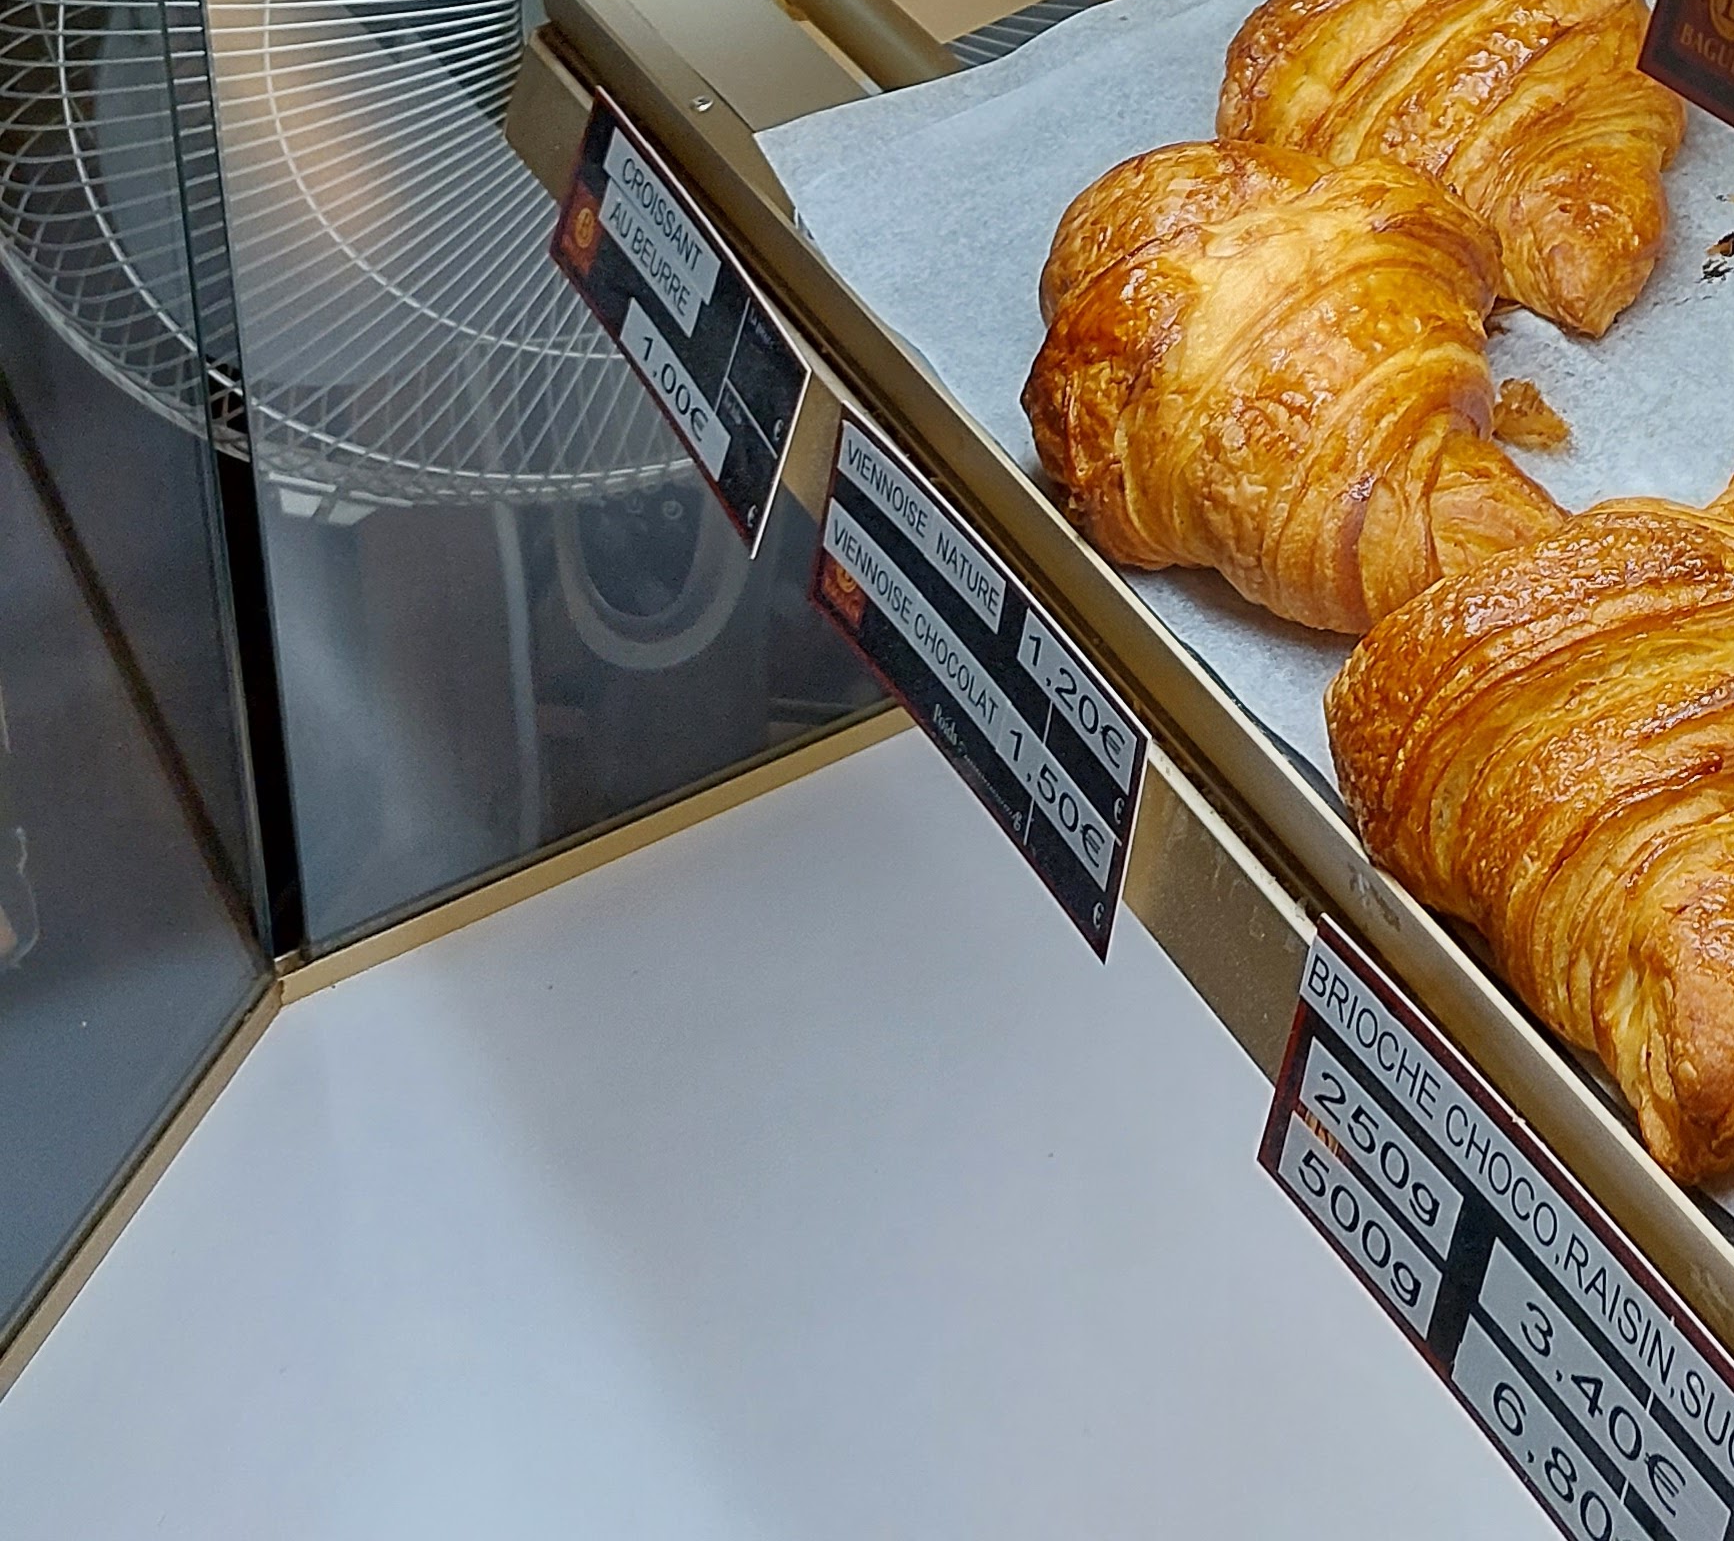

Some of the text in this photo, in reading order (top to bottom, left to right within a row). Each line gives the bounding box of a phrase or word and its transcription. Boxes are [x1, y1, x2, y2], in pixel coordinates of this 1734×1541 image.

[608, 201, 692, 317] AU BEURRE
[621, 156, 704, 273] CROISSANT
[847, 437, 1127, 771] VIENNOISE NATURE 1,20€
[832, 519, 914, 627] VIENNOISE
[913, 612, 1000, 726] CHOCOLAT
[1009, 728, 1107, 869] 1,50€
[1306, 953, 1442, 1113] BRIOCHE
[1297, 1149, 1424, 1311] 500g
[1313, 1070, 1442, 1230] 250g
[1492, 1380, 1624, 1541] 6,80
[1520, 1299, 1688, 1517] 3,40€
